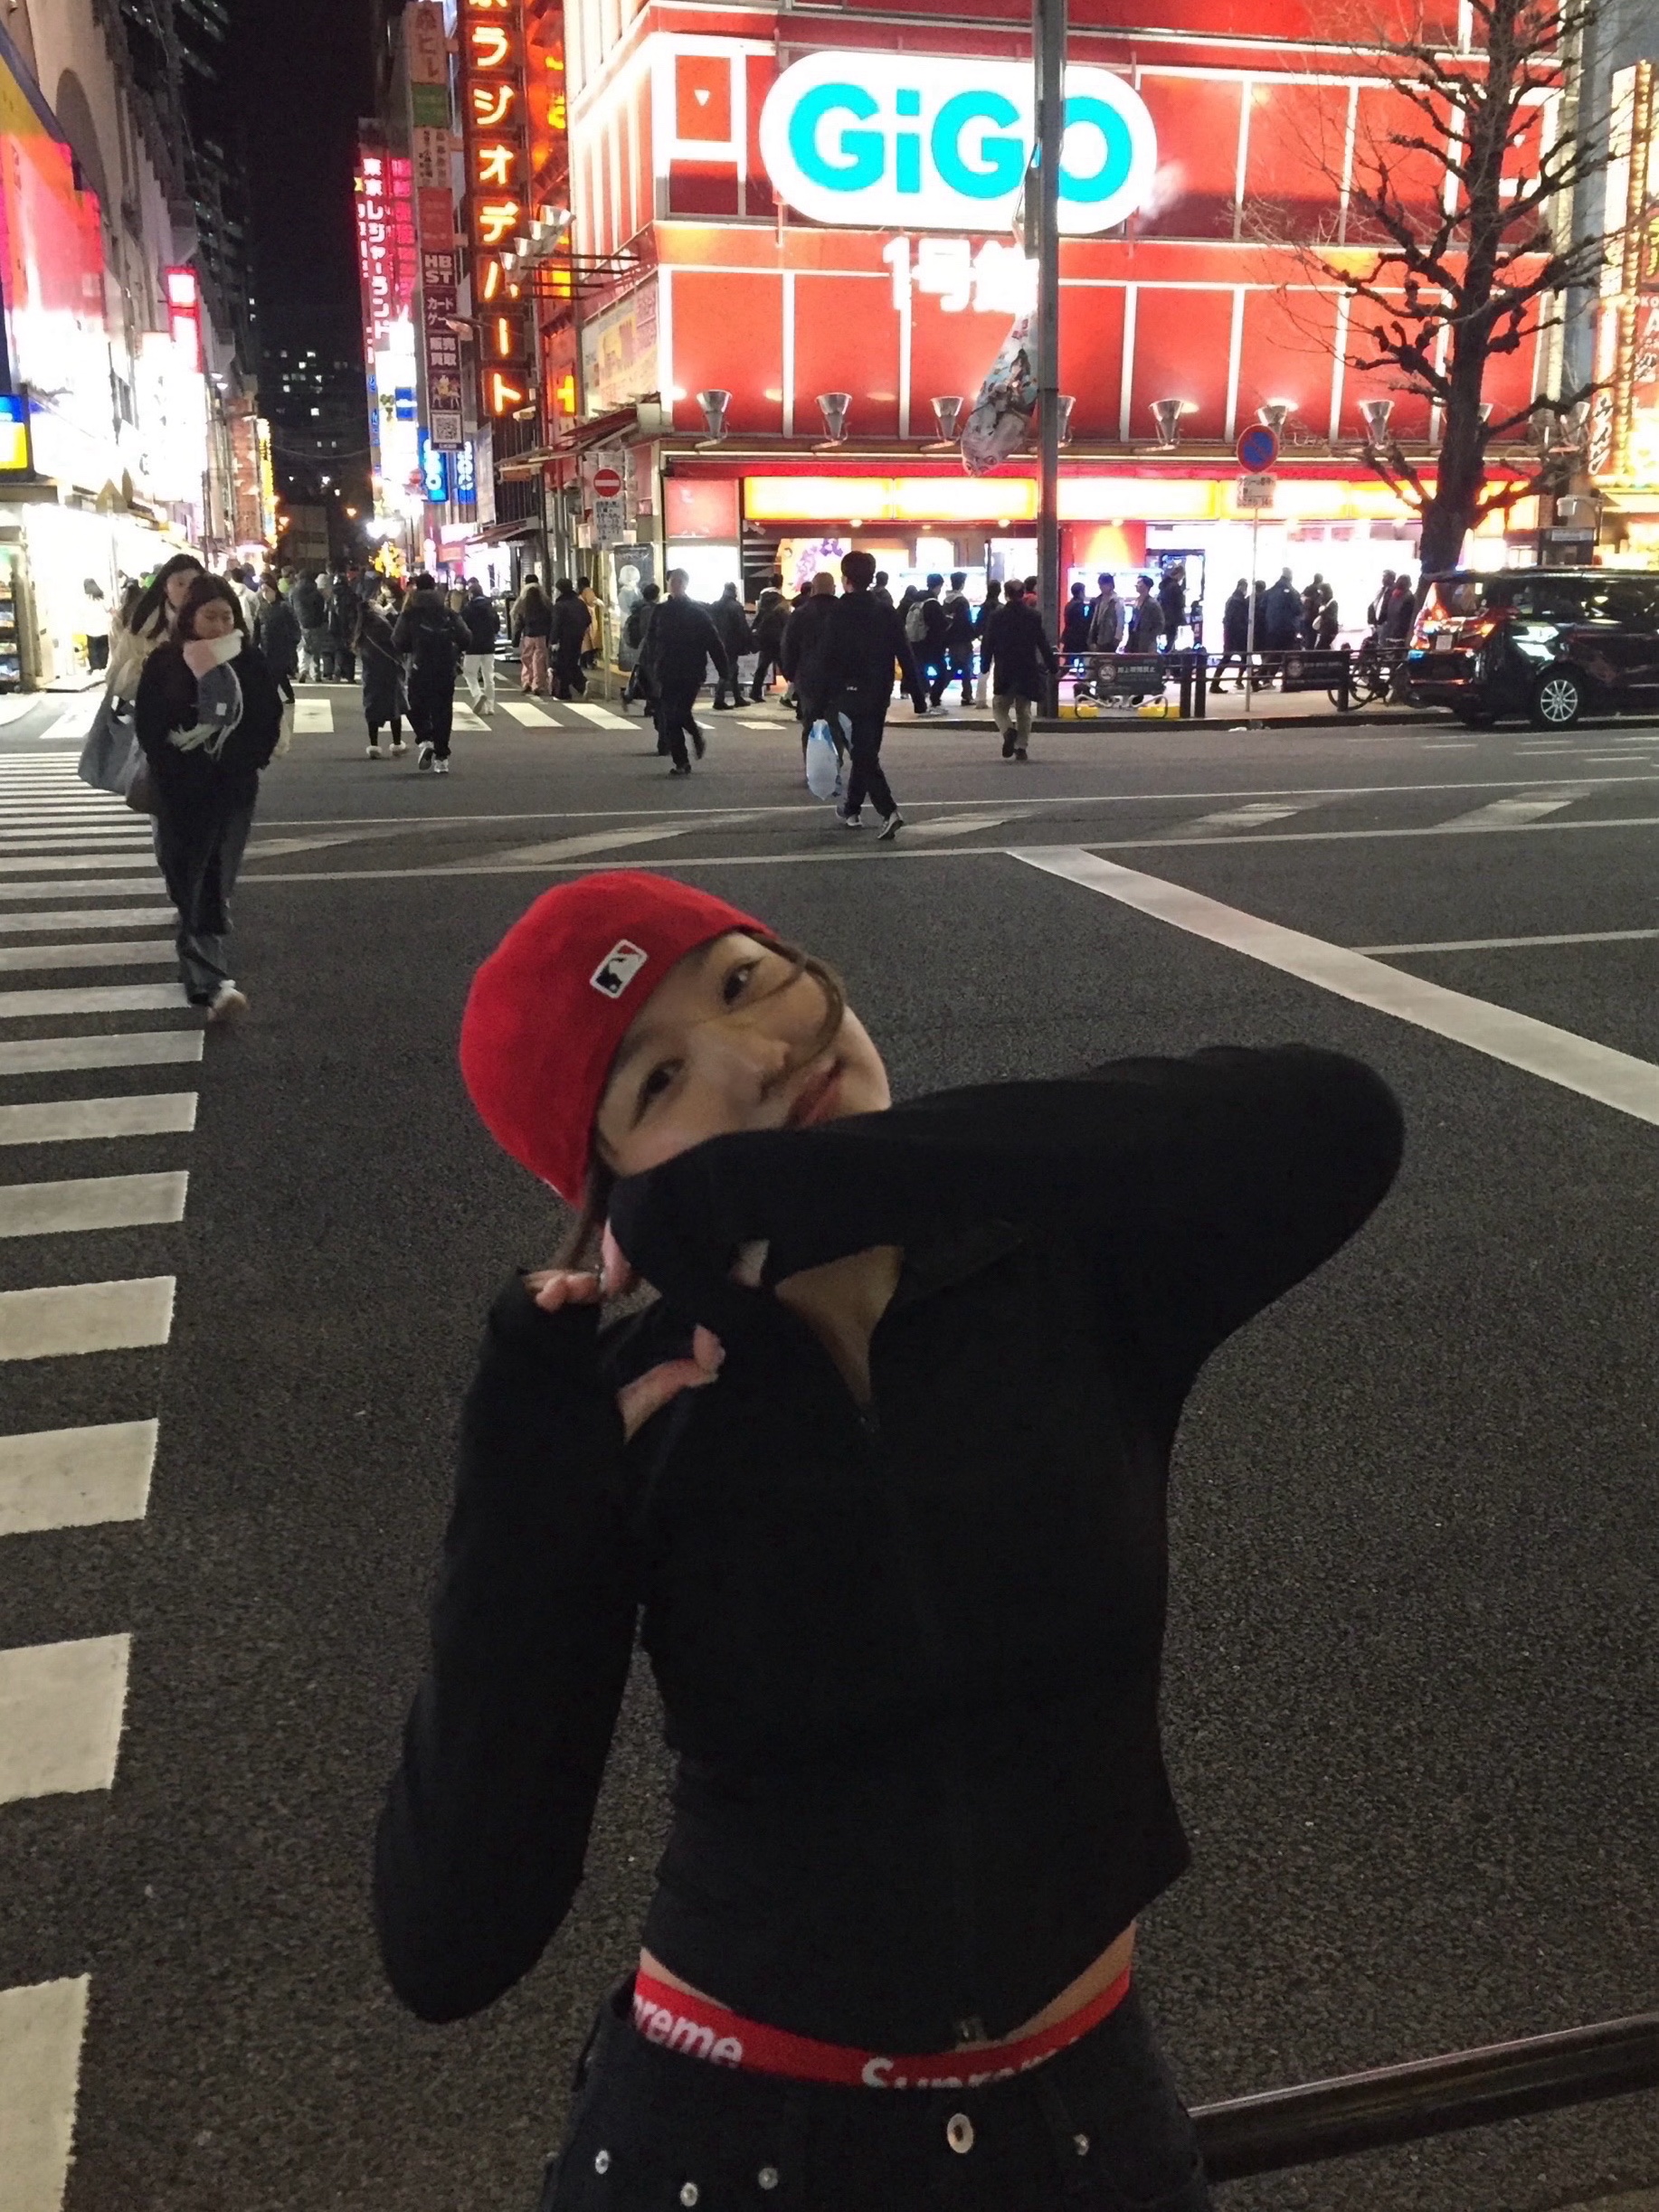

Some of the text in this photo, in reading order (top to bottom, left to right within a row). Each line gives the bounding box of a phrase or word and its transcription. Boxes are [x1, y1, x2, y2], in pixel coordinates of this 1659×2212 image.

[789, 82, 1133, 203] GiGO
[469, 0, 522, 413] ラジオデート
[424, 254, 452, 268] HB
[425, 270, 452, 284] ST
[427, 297, 453, 310] カード
